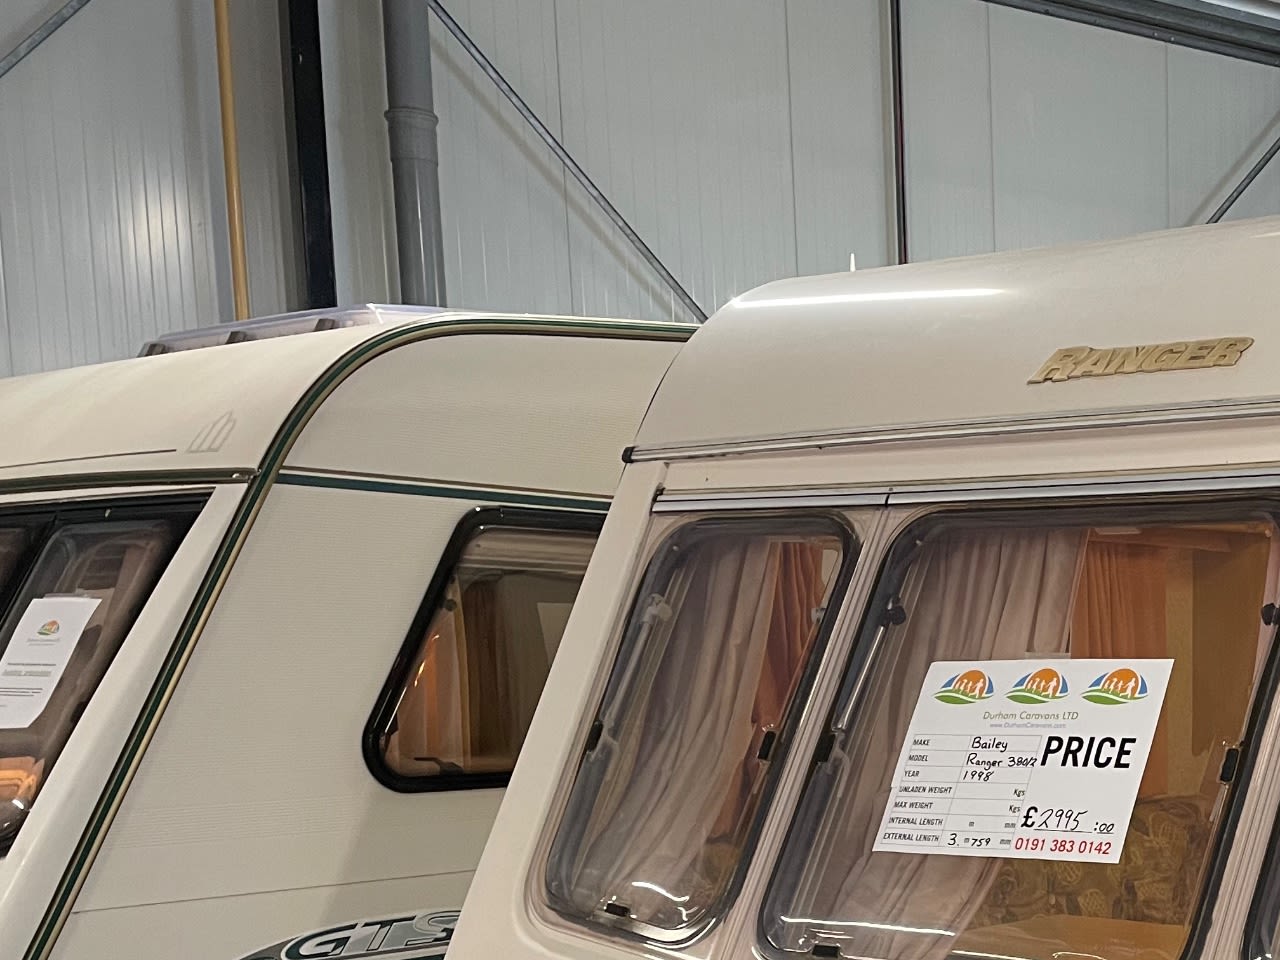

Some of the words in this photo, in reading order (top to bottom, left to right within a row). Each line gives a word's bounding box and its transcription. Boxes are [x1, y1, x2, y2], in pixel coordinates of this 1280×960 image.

[1027, 337, 1254, 384] RANGER
[983, 710, 1017, 720] Durham
[1019, 710, 1059, 720] Caravans
[1062, 711, 1079, 720] LTD
[971, 736, 1008, 752] Bailey
[1040, 736, 1137, 768] PRICE
[908, 754, 929, 762] MODEL
[966, 753, 1003, 771] Ranger
[963, 770, 995, 782] 1998
[889, 817, 917, 825] INTERNAL
[919, 818, 944, 826] LENGTH
[883, 833, 914, 841] EXTERNAL
[915, 834, 940, 842] LENGTH
[971, 838, 991, 847] 759
[1015, 838, 1045, 851] 0191
[1050, 839, 1075, 852] 383
[1078, 841, 1112, 855] 0142
